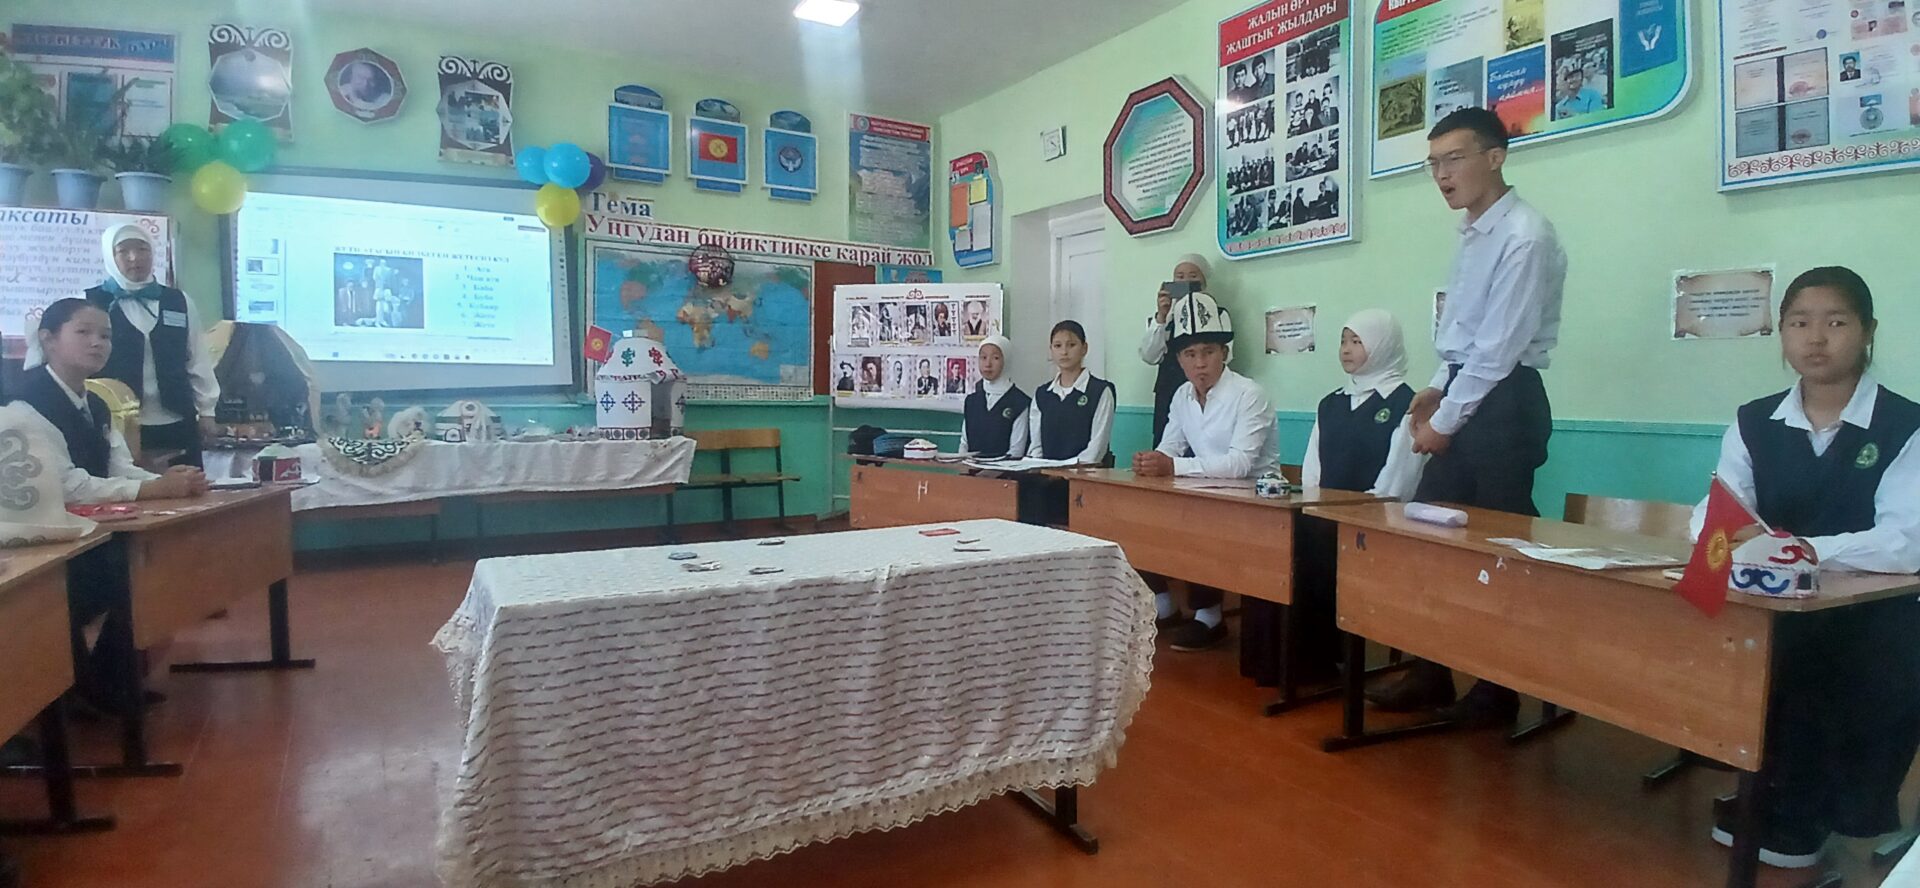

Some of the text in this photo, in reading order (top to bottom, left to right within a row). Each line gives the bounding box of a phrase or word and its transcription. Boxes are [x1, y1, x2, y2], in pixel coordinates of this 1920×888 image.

[1226, 1, 1337, 55] ЖАШТЫК ЖЫЛДАРЫ
[1248, 2, 1289, 30] ЖАЛЫН
[697, 228, 831, 258] бийиктикке
[836, 245, 891, 267] карай
[898, 252, 933, 266] жол
